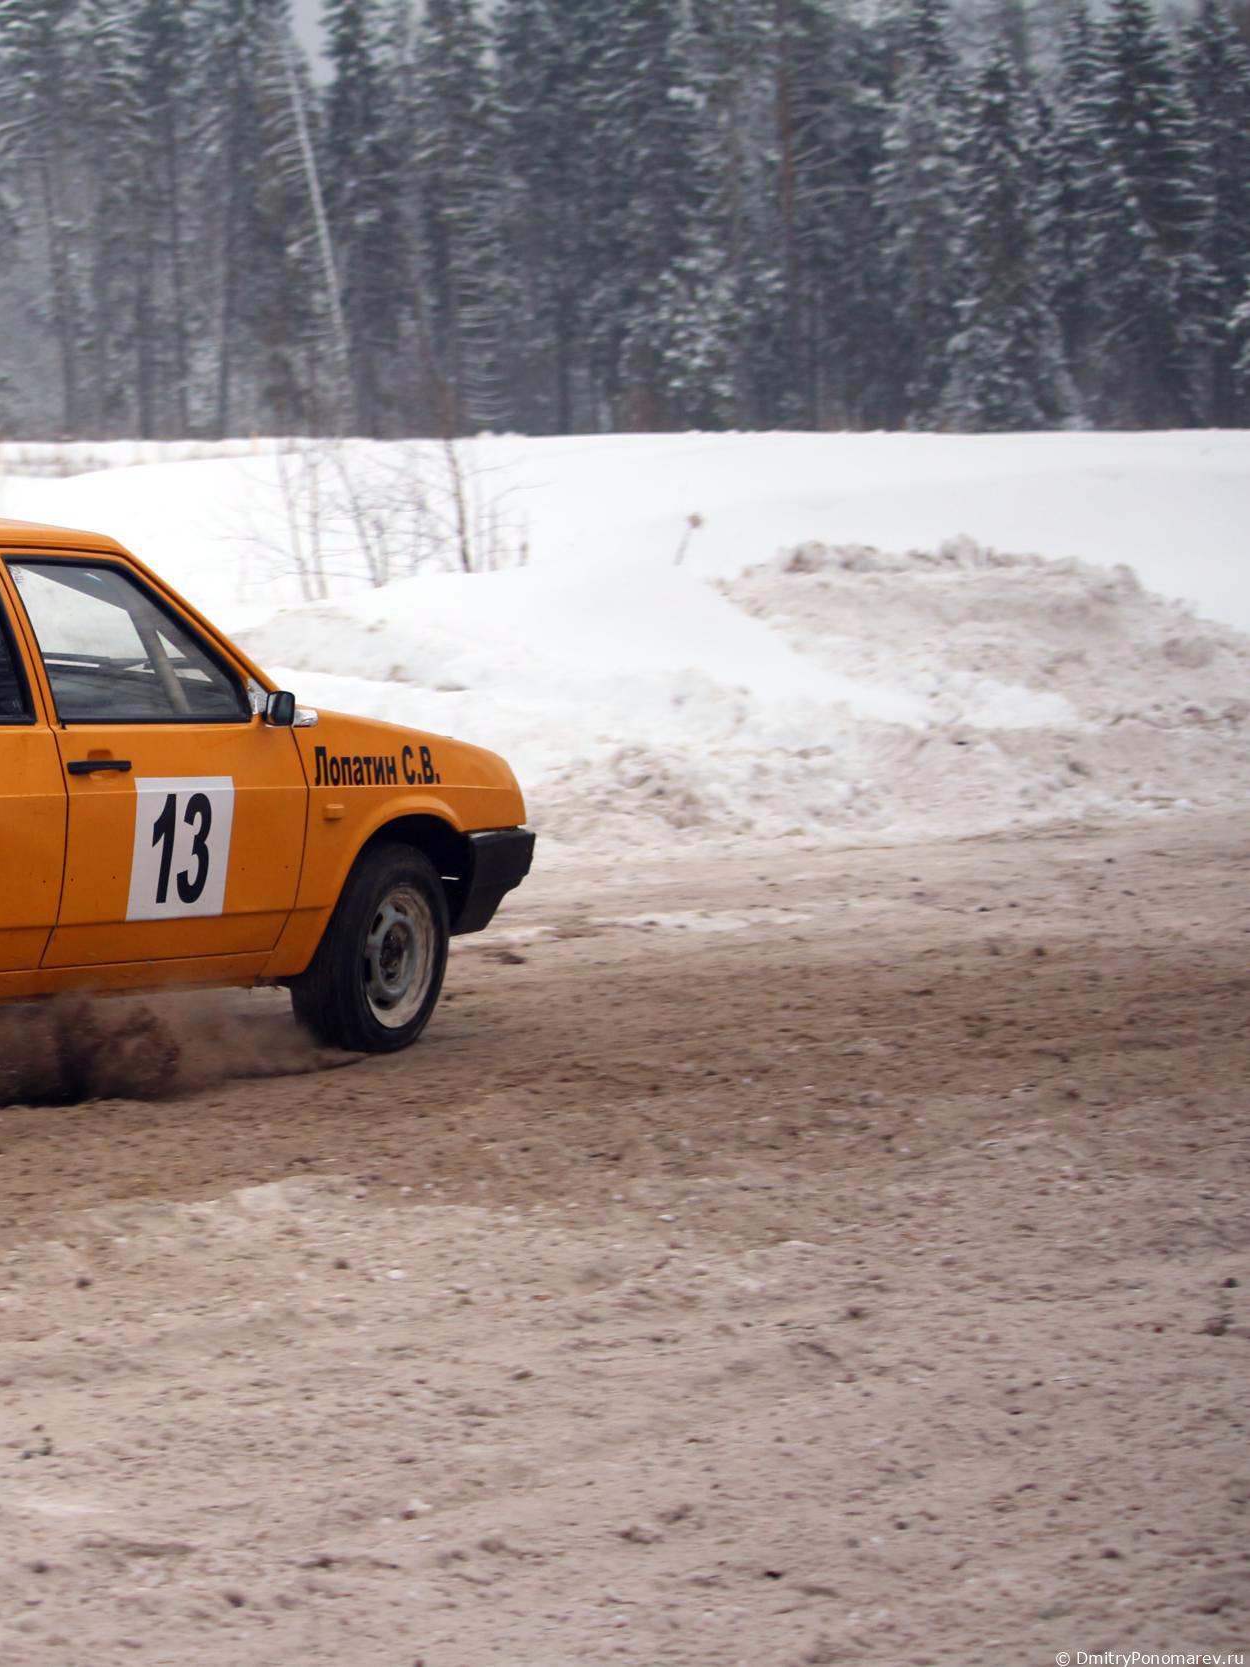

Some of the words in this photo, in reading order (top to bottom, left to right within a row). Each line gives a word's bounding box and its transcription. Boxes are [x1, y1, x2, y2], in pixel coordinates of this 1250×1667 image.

[314, 745, 398, 787] Лопатин
[401, 744, 441, 786] С.В.
[152, 792, 212, 905] 13
